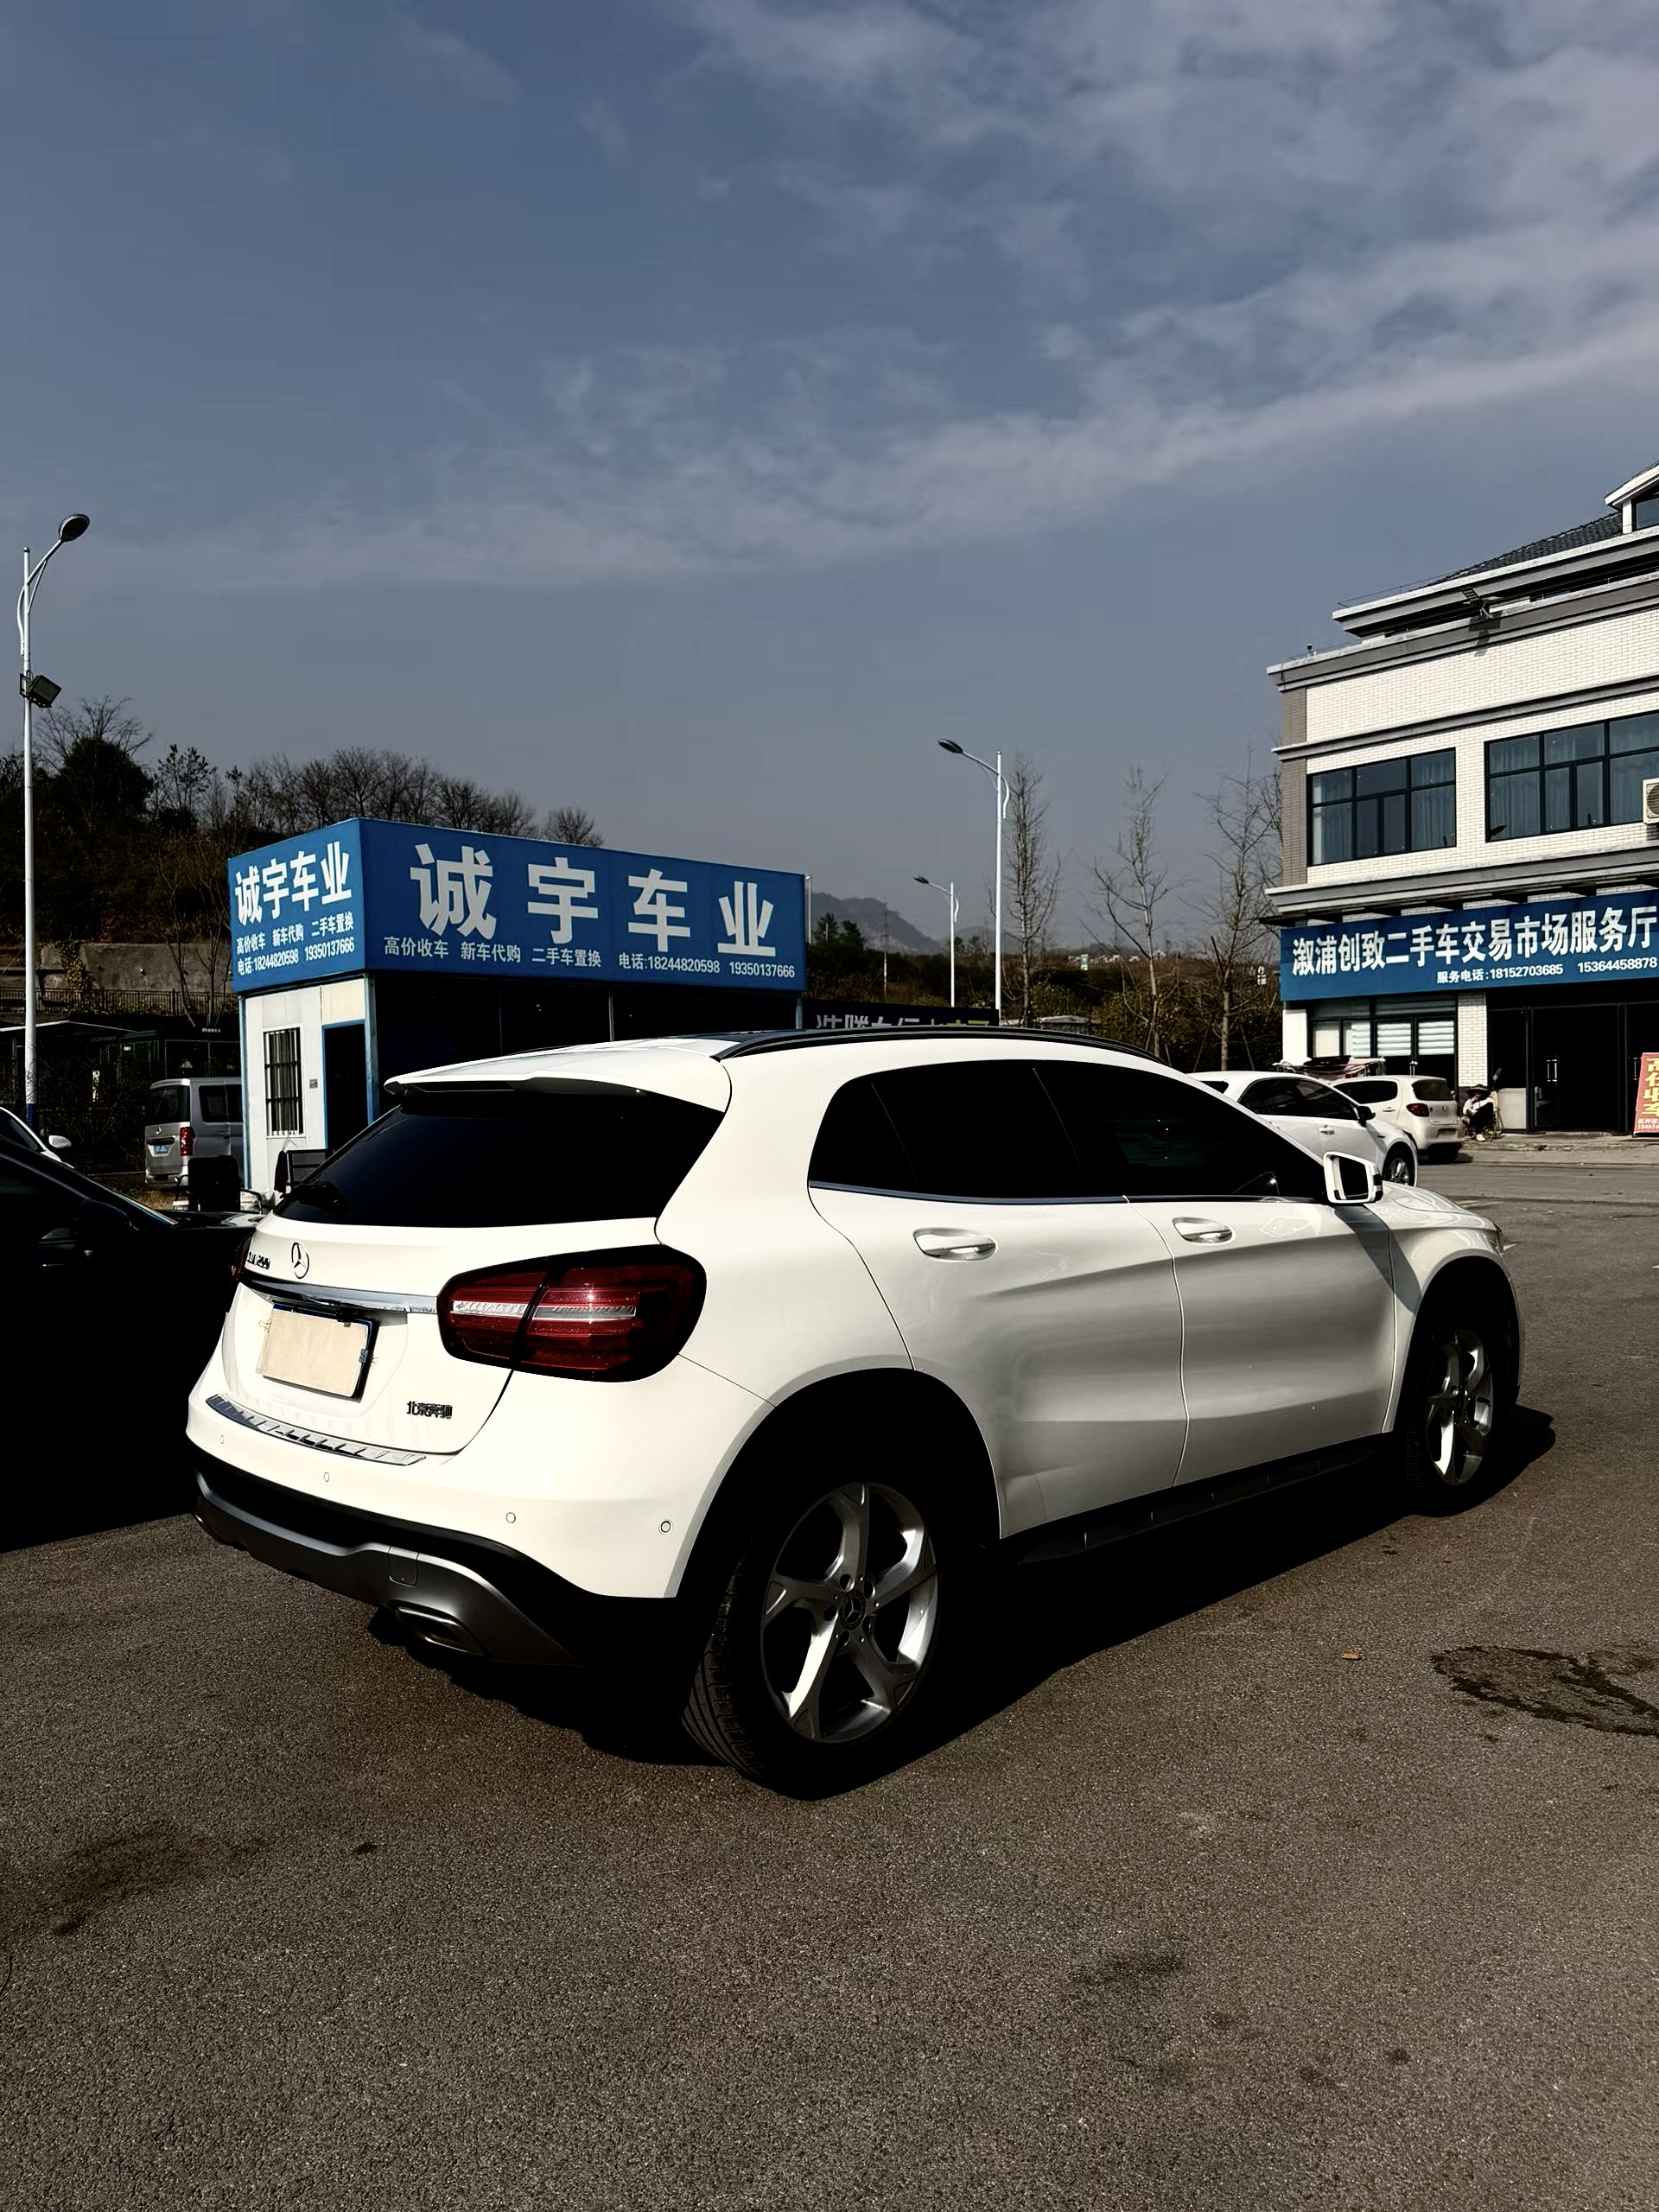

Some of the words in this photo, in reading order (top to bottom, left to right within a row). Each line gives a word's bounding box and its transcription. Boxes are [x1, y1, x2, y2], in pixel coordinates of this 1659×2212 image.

[235, 841, 352, 926] 诚宇车业
[410, 843, 776, 957] 诚宇车业
[236, 932, 265, 955] 高价收车
[272, 923, 304, 947] 新车代购
[311, 912, 354, 937] 二手车置换
[1292, 906, 1657, 976] 溆浦创致二手车交易市场服务厅
[238, 949, 299, 976] 电话:18244820598
[304, 937, 355, 961] 19350137666
[384, 936, 448, 958] 高价收车
[461, 941, 521, 963] 新车代购
[531, 948, 601, 968] 二手车置换
[619, 952, 721, 973] 电话:18244820598
[729, 962, 795, 977] 19350137666
[1436, 963, 1564, 984] 服务电话:18152703685
[1577, 957, 1657, 974] 15364458878
